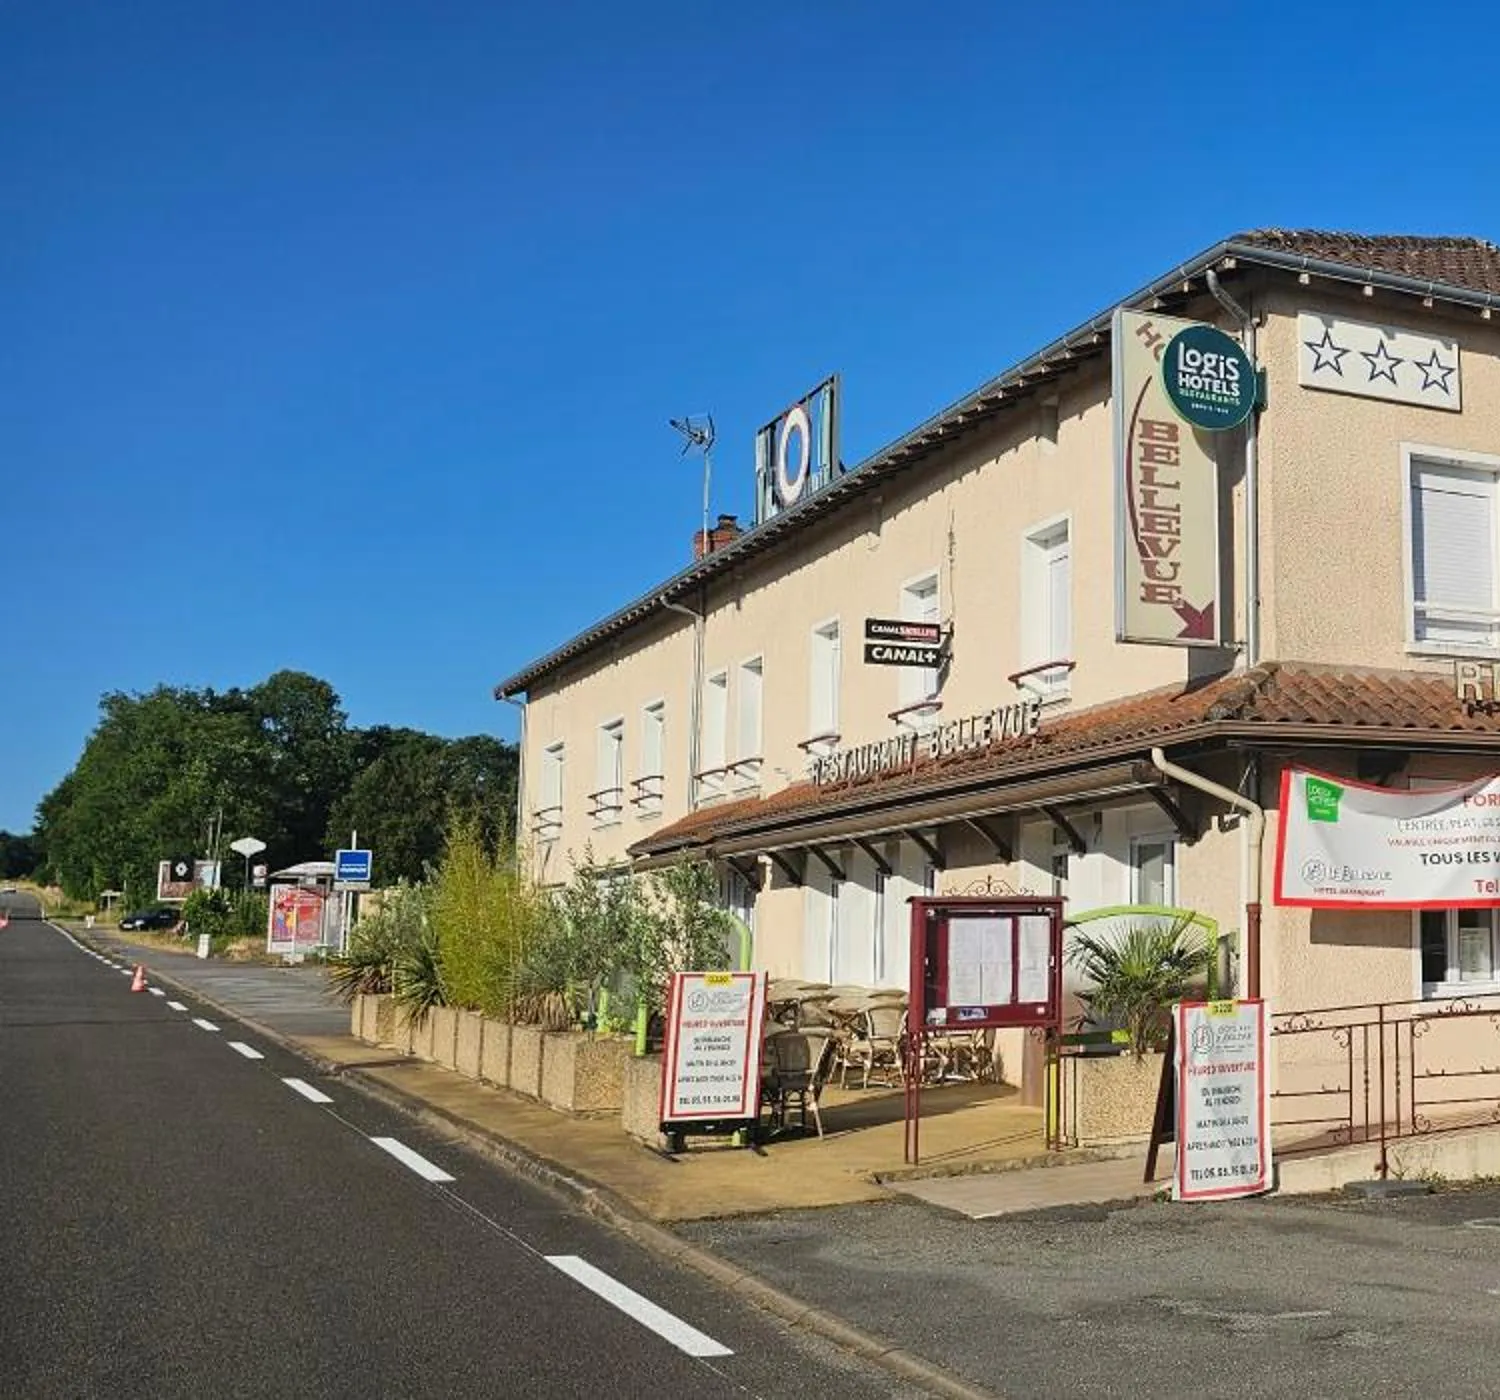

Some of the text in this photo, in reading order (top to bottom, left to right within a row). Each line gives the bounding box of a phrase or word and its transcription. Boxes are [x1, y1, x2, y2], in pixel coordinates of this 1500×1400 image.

[1178, 372, 1241, 397] HOTELS
[1138, 419, 1182, 607] BELLEVUE
[871, 647, 937, 663] CANAL+
[810, 698, 1043, 786] RESTAURANT BELLEVUE
[1420, 852, 1463, 865] TOUS
[1467, 852, 1490, 864] LES
